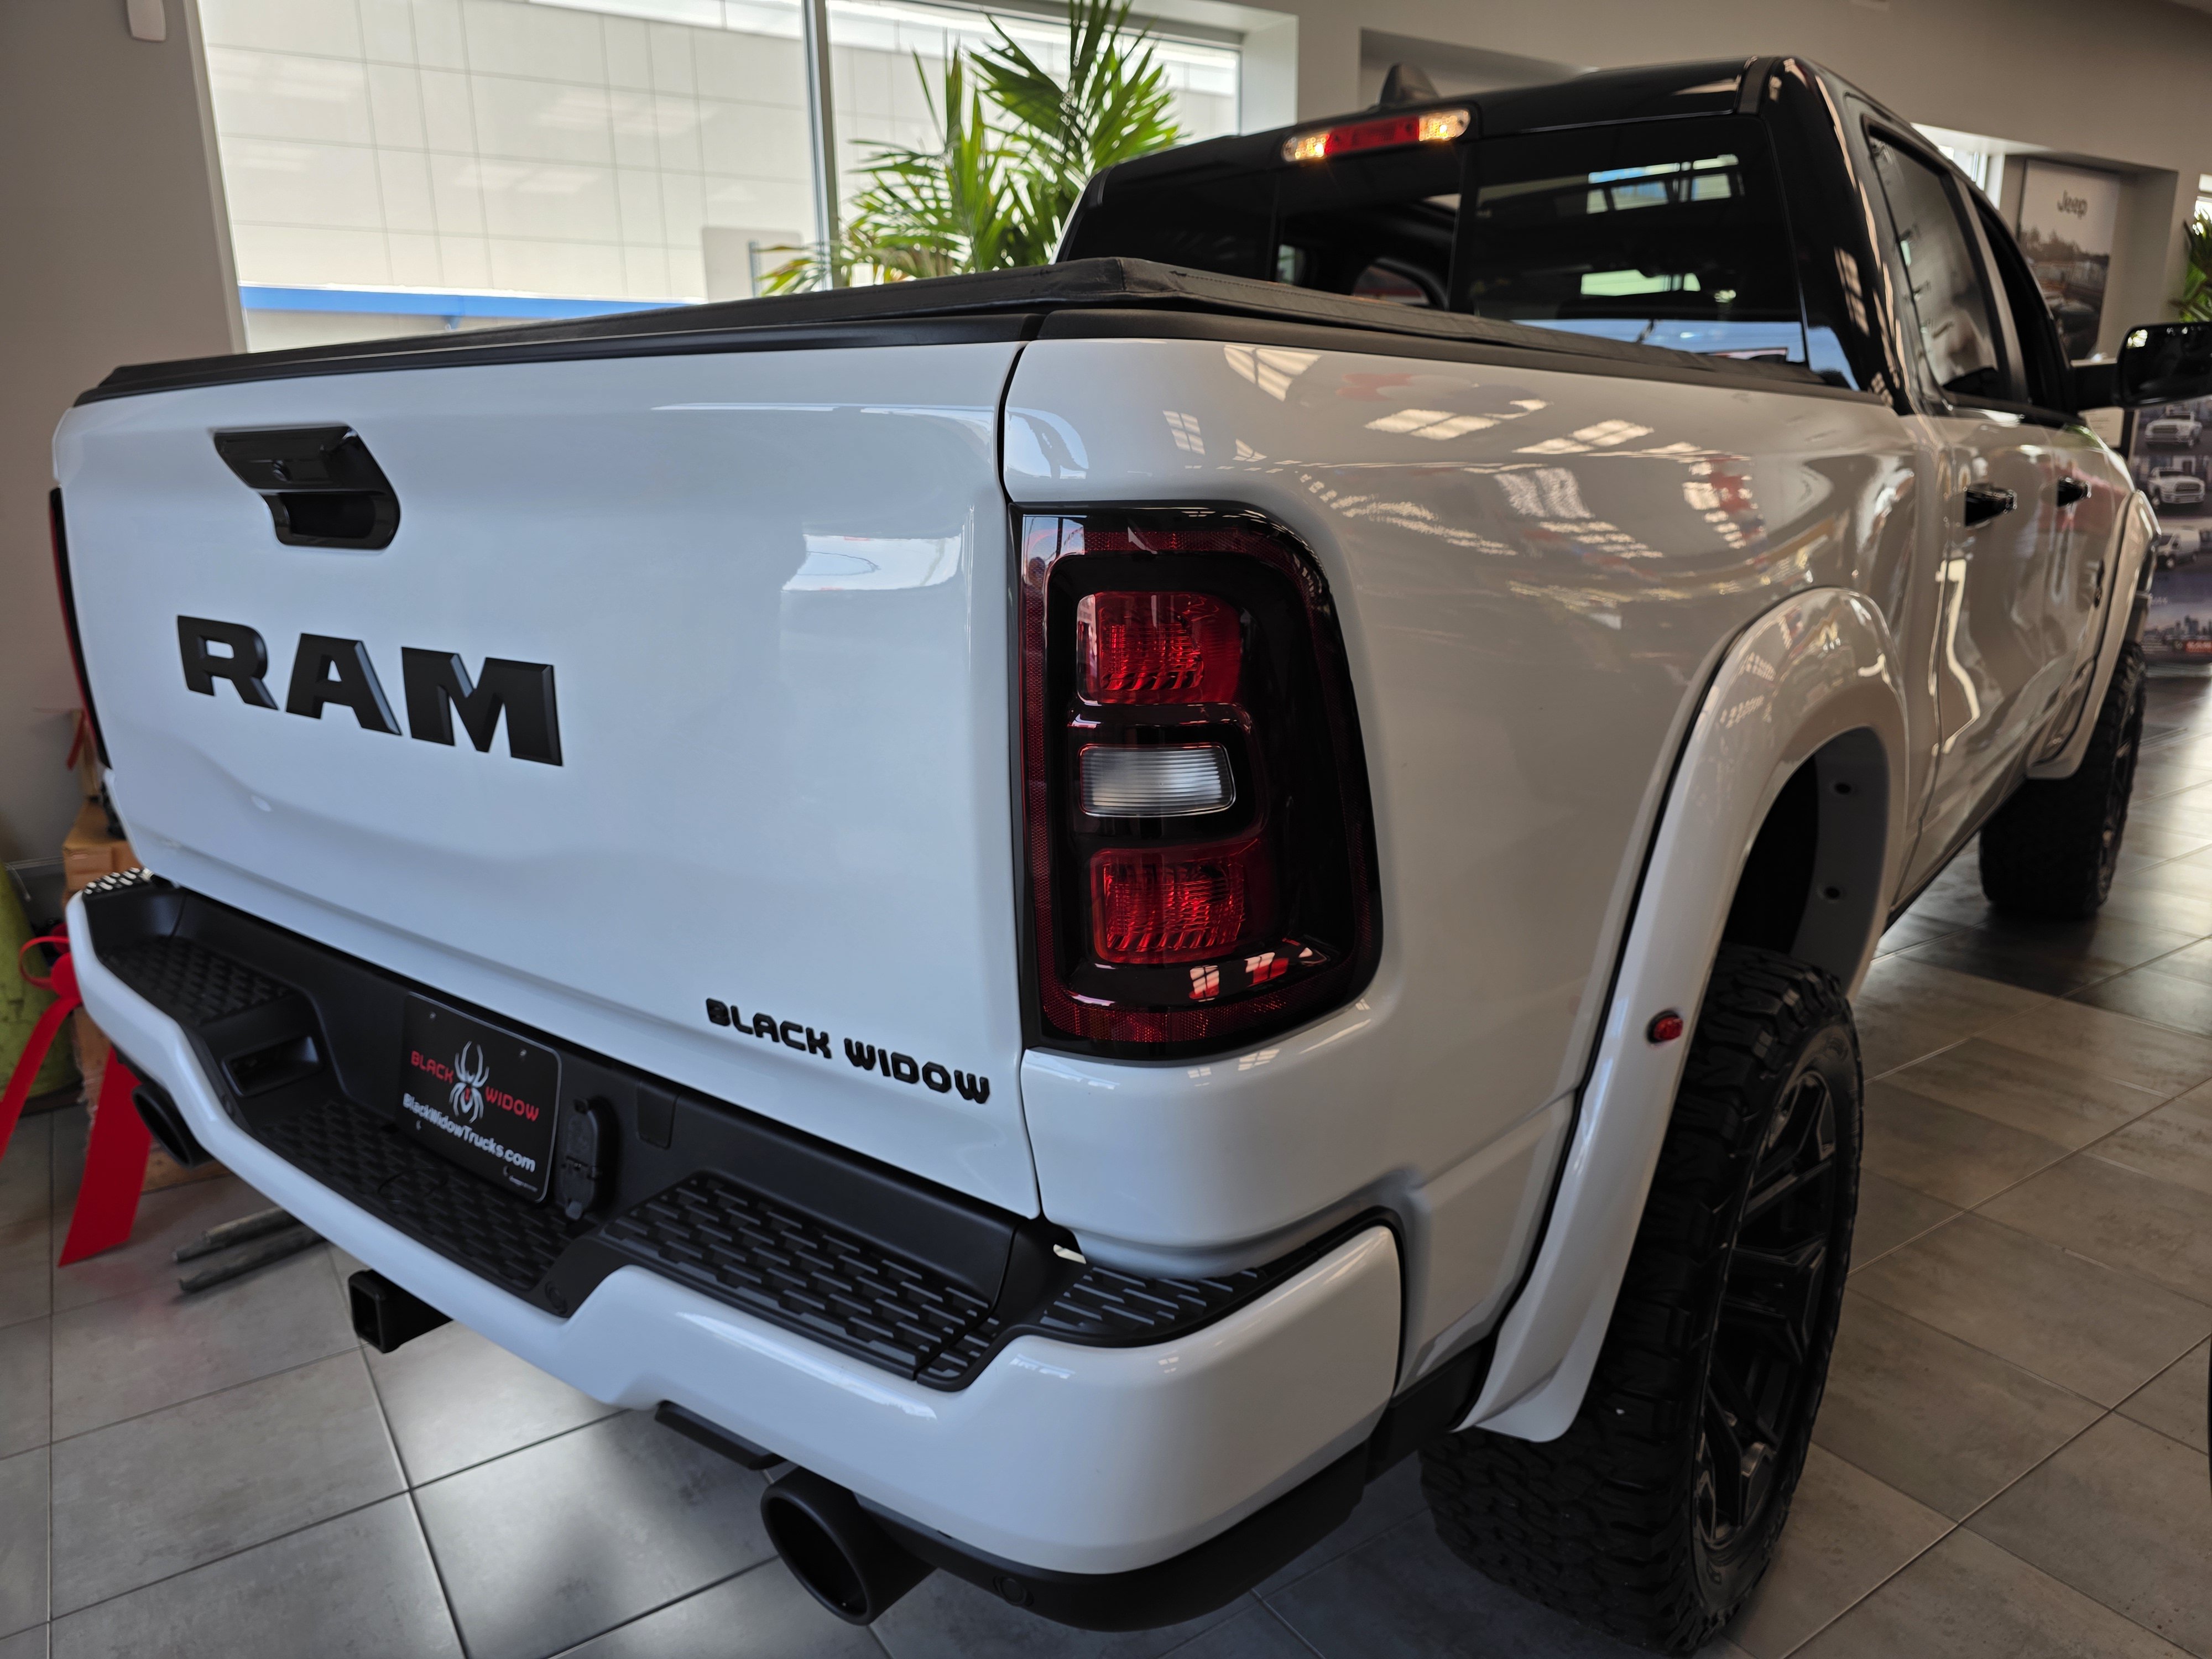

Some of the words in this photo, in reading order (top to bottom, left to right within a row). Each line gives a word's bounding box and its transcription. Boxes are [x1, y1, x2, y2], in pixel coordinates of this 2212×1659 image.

[2057, 190, 2088, 220] Jeep
[177, 614, 563, 766] RAM
[411, 1051, 453, 1083] BLACK
[486, 1087, 539, 1121] WIDOW
[706, 998, 832, 1059] BLACK
[844, 1037, 990, 1104] WIDOW
[403, 1093, 536, 1172] BlackWidowTrucks.com
